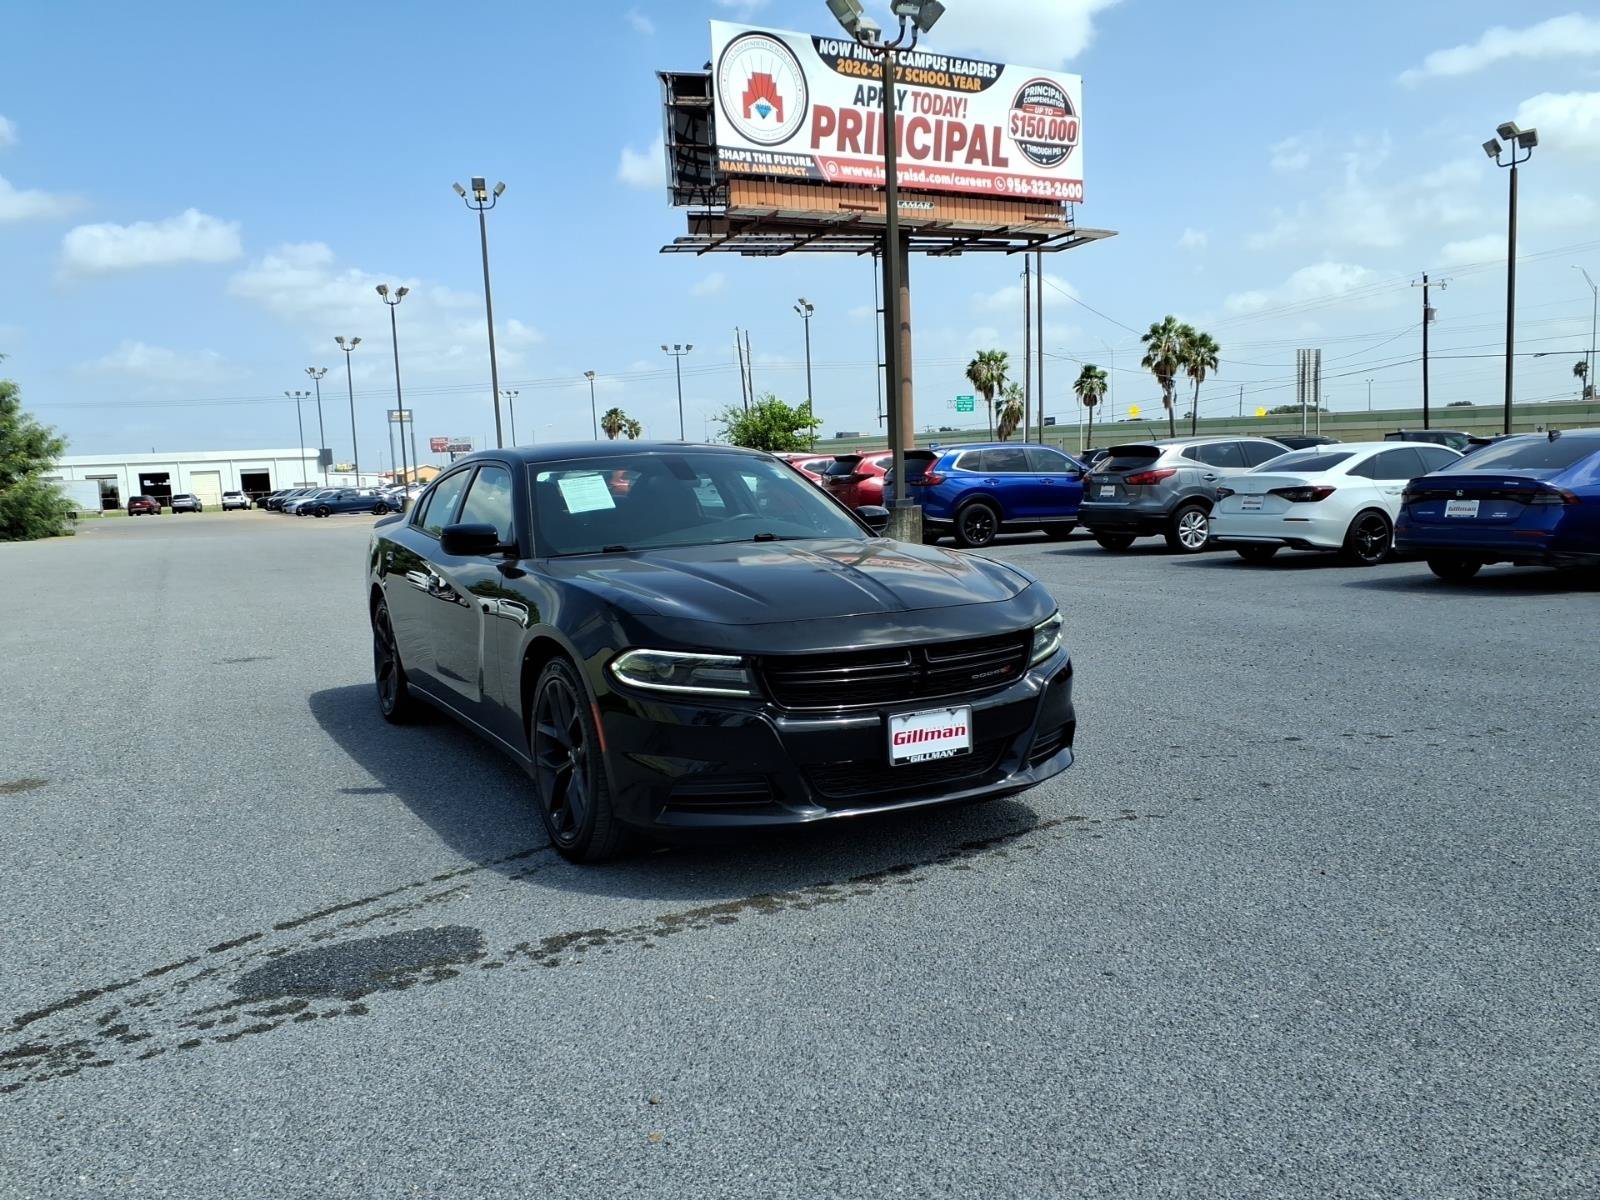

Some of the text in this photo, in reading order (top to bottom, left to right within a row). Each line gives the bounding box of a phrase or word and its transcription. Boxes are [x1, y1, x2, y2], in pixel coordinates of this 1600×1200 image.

[819, 39, 851, 57] NOW
[899, 51, 948, 70] CAMPUS
[950, 59, 997, 78] LEADERS
[837, 58, 982, 91] 2026-27 SCHOOL YEAR
[853, 84, 968, 119] APPY TODAY!
[1023, 96, 1065, 108] COMPENSATION
[1025, 85, 1064, 101] PRINCIPAL
[1034, 106, 1053, 115] UP TO
[810, 104, 1009, 168] PRINCIPAL
[1010, 112, 1077, 143] $150,000
[718, 149, 815, 167] SHAPE THE FUTURE.
[1026, 144, 1052, 156] THROUGH
[719, 161, 809, 176] MAKE AN IMPACT.
[1006, 177, 1083, 198] 956-323-2600
[893, 726, 966, 746] Gillman
[910, 750, 955, 763] GILLMAN
